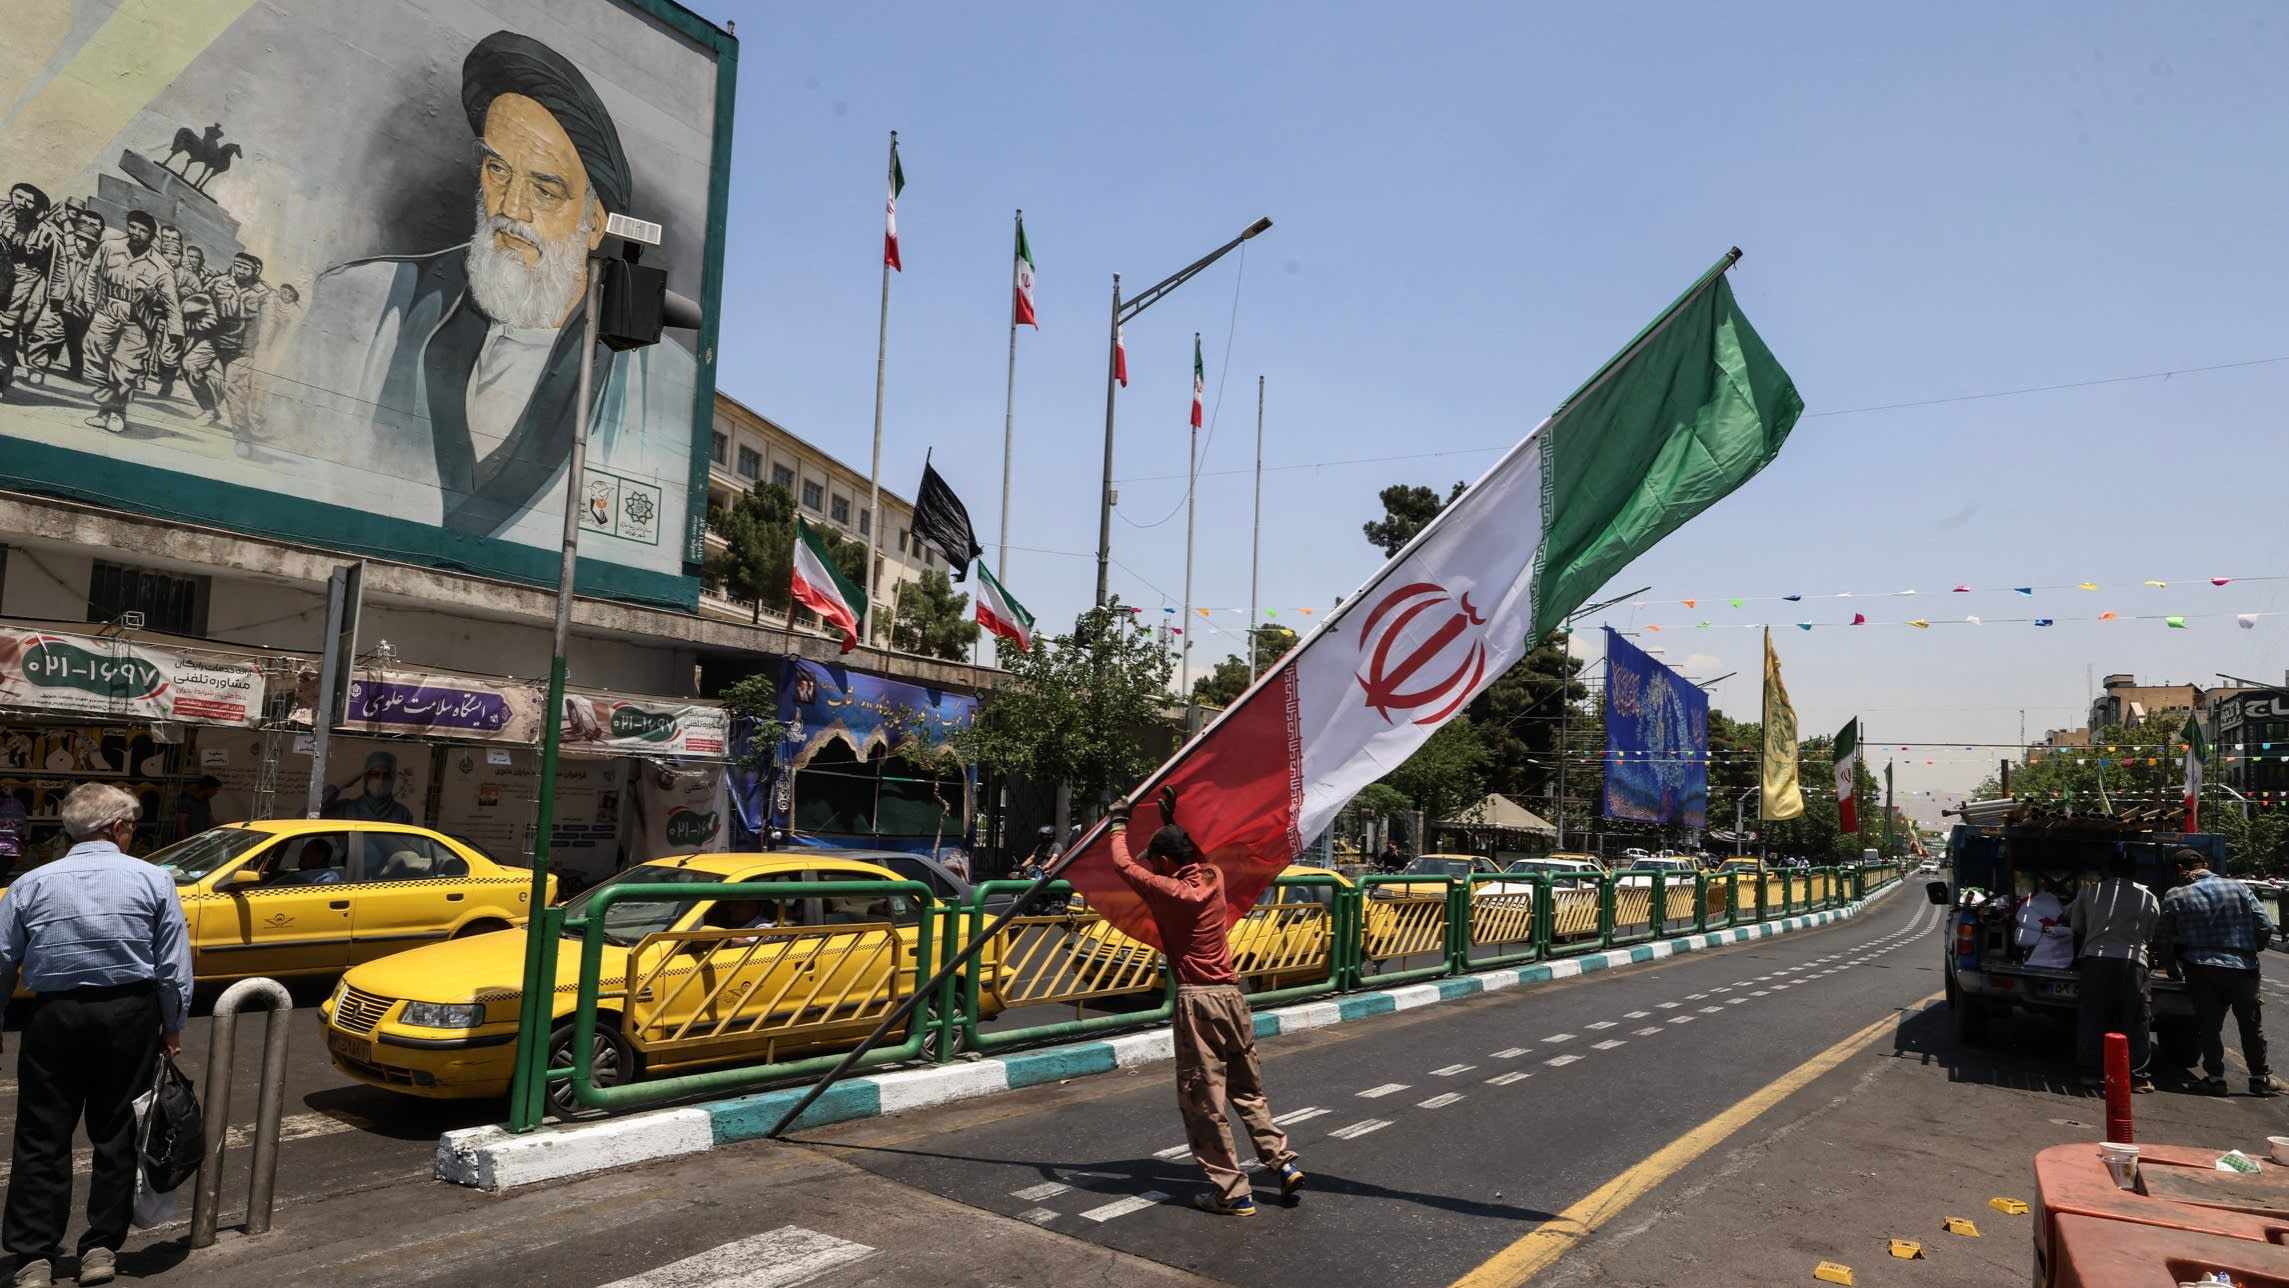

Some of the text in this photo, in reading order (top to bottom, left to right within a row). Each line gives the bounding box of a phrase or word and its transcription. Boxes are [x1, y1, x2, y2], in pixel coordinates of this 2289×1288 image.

[173, 672, 251, 690] مشاوره تلفنی
[362, 690, 486, 727] ایستگاه سلامت علوی
